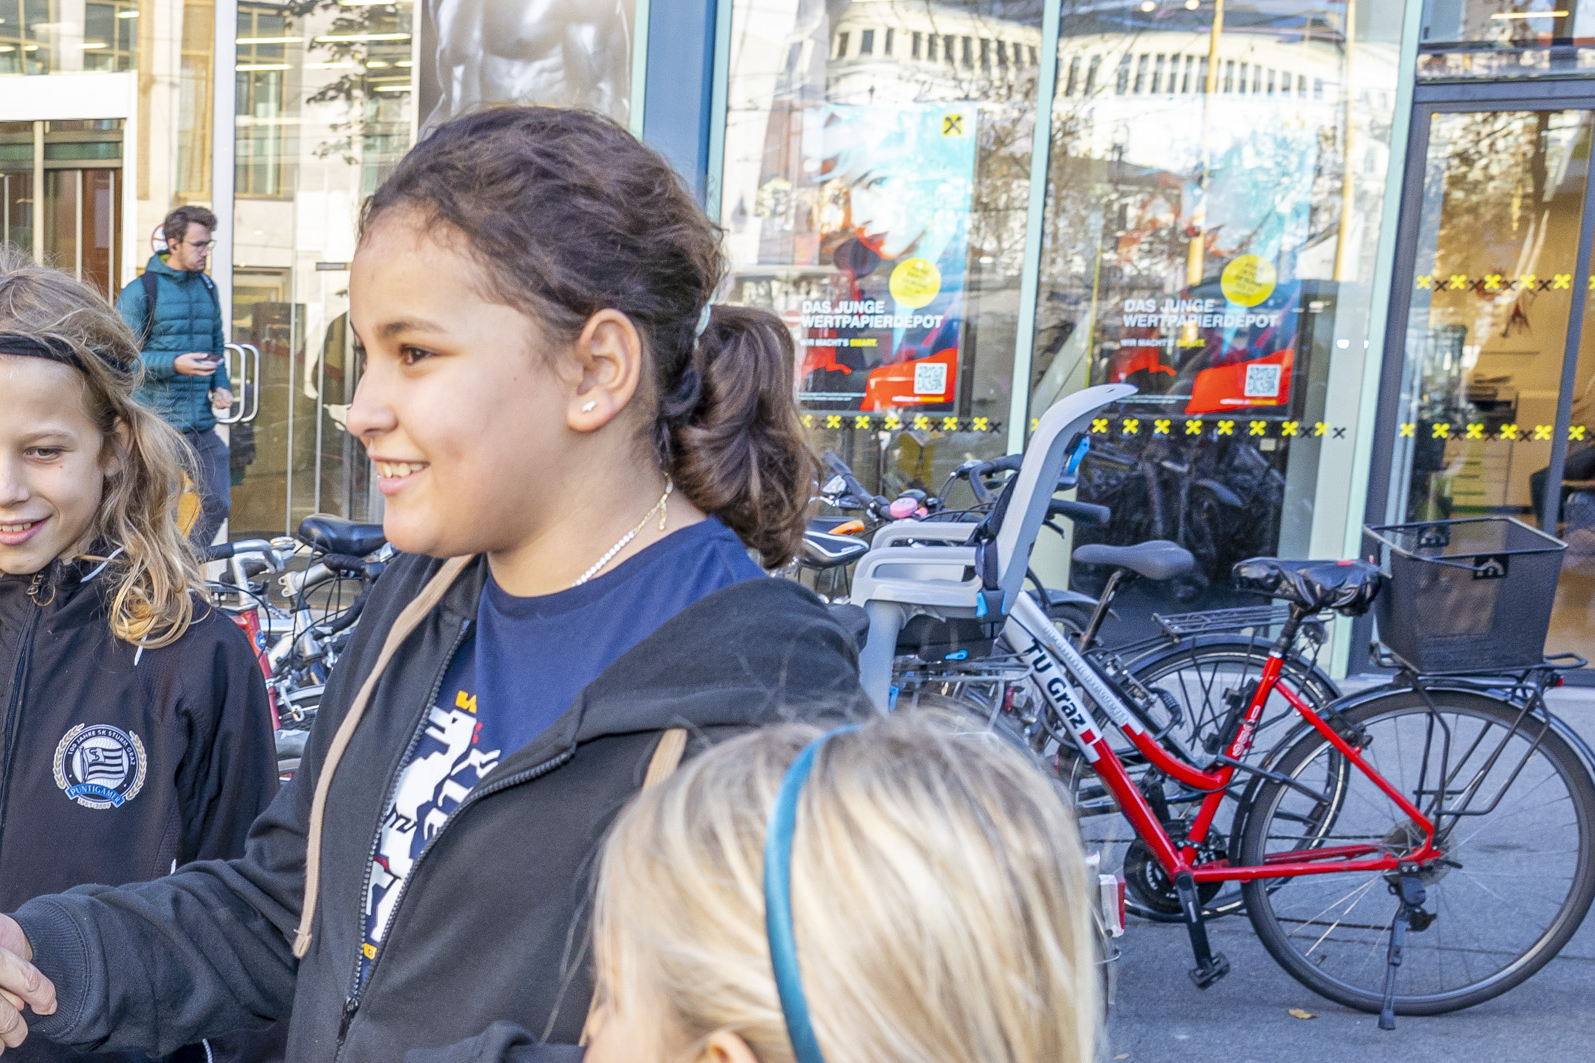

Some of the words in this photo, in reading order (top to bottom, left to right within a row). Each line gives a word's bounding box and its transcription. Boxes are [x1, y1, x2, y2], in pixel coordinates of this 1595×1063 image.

[802, 300, 833, 314] DAS
[835, 300, 886, 314] JUNGE
[1124, 299, 1156, 313] DAS
[1160, 299, 1215, 313] JUNGE
[801, 315, 943, 329] WERTPAPIERDEPOT
[1123, 314, 1279, 328] WERTPAPIERDEPOT
[1023, 638, 1053, 674] TU
[1047, 677, 1087, 730] Graz
[67, 743, 78, 755] 100
[77, 730, 97, 745] JAHRE
[108, 730, 128, 747] STURM
[126, 746, 136, 766] GRAZ
[69, 784, 121, 803] PUNTIGAMER
